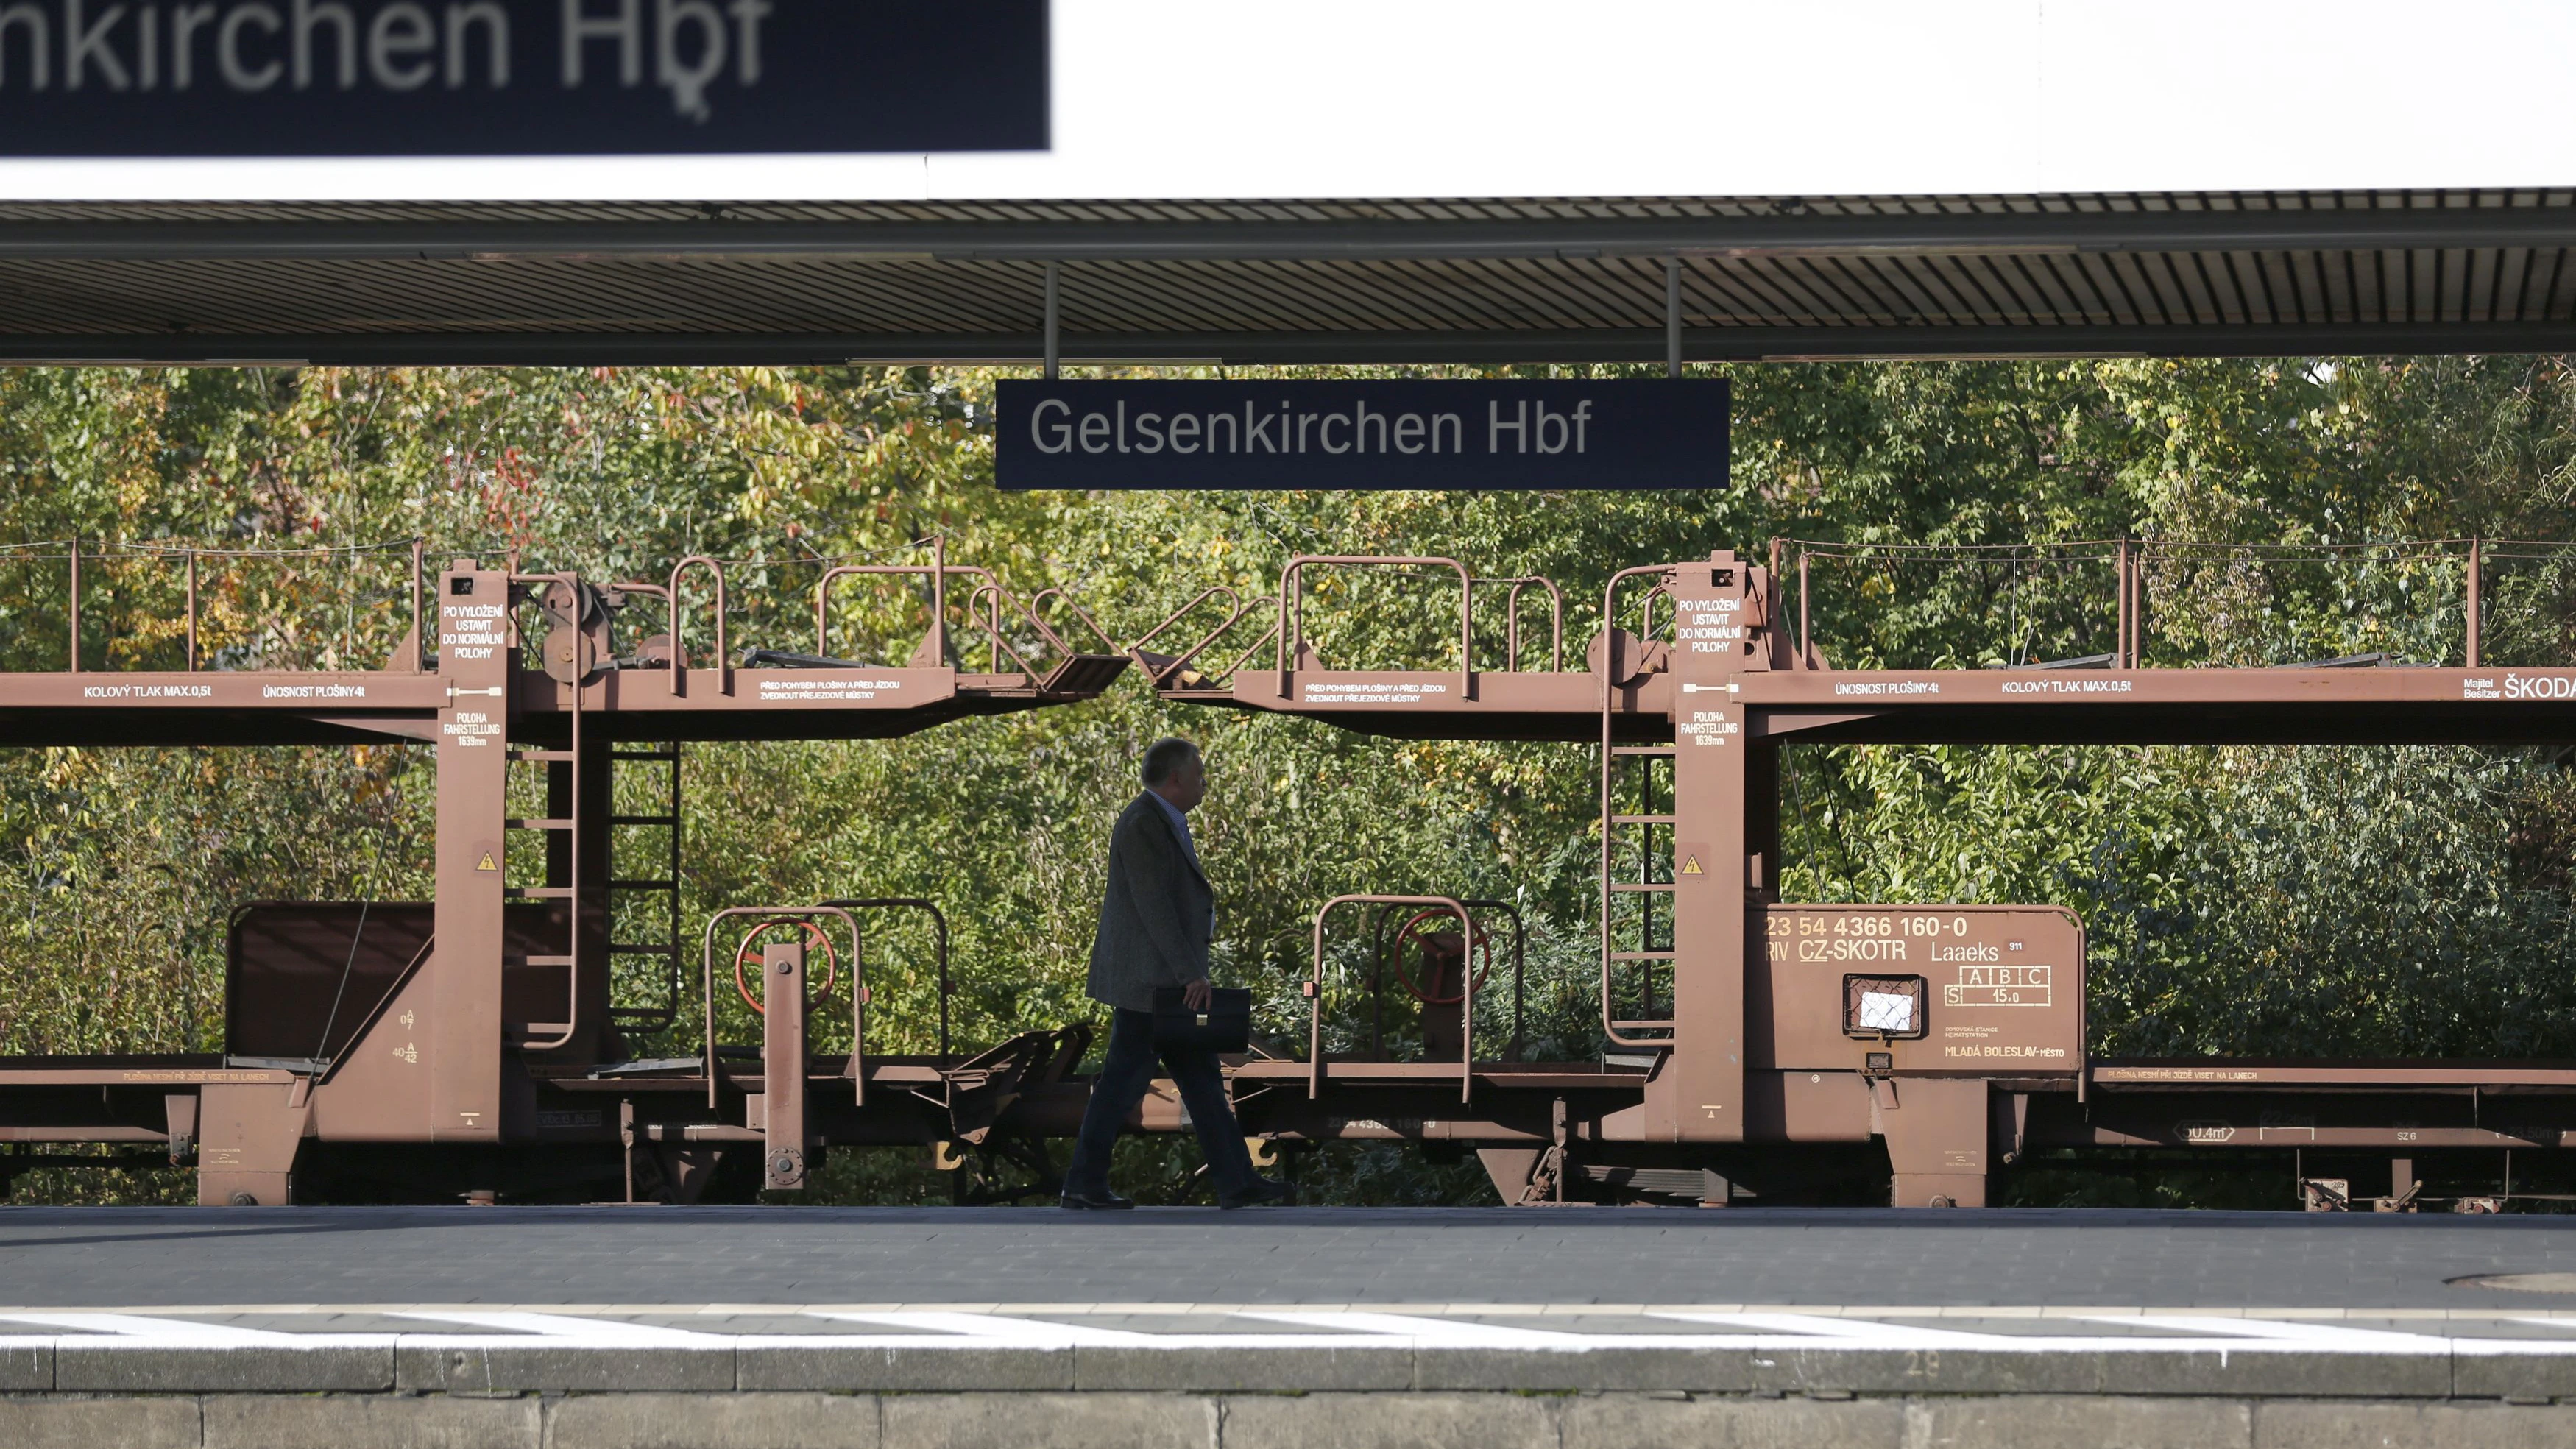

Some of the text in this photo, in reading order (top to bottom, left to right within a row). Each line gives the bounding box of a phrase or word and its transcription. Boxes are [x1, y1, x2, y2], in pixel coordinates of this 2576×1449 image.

[1031, 399, 1592, 454] Gelsenkirchen Hbf
[443, 604, 503, 617] PO VYLOŽENÍ
[1680, 598, 1740, 612] PO VYLOŽENÍ
[1692, 613, 1730, 625] USTAVIT
[456, 620, 492, 631] USTAVIT
[442, 631, 503, 645] DO NORMÁLNÍ
[1679, 625, 1741, 639] DO NORMÁLNÍ
[1691, 641, 1730, 652] POLOHY
[455, 647, 492, 659] POLOHY
[760, 681, 781, 690] PŘED
[781, 681, 816, 690] POHYBEM
[817, 680, 846, 689] PLOŠINY
[854, 680, 874, 689] PŘED
[874, 680, 899, 689] JÍZDOU
[1305, 683, 1326, 692] PŘED
[1362, 683, 1393, 692] PLOŠINY
[1399, 683, 1419, 692] PŘED
[1420, 683, 1446, 692] JÍZDOU
[1835, 681, 1887, 695] ÚNOSNOST
[2002, 679, 2049, 692] KOLOVÝ
[2051, 681, 2081, 692] TLAK
[2464, 678, 2494, 690] Majitel
[84, 684, 132, 698] KOLOVÝ
[133, 686, 161, 697] TLAK
[263, 684, 315, 698] ÚNOSNOST
[760, 692, 798, 700] ZVEDNOUT
[2464, 688, 2501, 698] Besitzer
[1305, 695, 1343, 703] ZVEDNOUT
[456, 712, 487, 723] POLOHA
[1694, 712, 1725, 723] POLOHA
[443, 723, 500, 734] FAHRSTELLUNG
[1680, 723, 1738, 734] FAHRSTELLUNG
[1763, 916, 1791, 936] 23
[1799, 916, 1827, 936] 54
[1833, 916, 1892, 936] 4366
[1765, 938, 1999, 962] RIV CZ-SKOTR Laaeks
[2009, 942, 2022, 950] 911
[1970, 968, 2041, 985] A B C
[1948, 988, 1959, 1003] S
[392, 1047, 405, 1057] 40
[1945, 1044, 1981, 1057] MLADÁ
[2108, 1069, 2137, 1079] PLOŠINA
[2138, 1069, 2160, 1079] NESMÍ
[2160, 1070, 2171, 1079] PŘI
[2173, 1070, 2193, 1079] JÍZDĚ
[2229, 1071, 2257, 1080] LANECH
[2397, 1132, 2416, 1141] SZ 6
